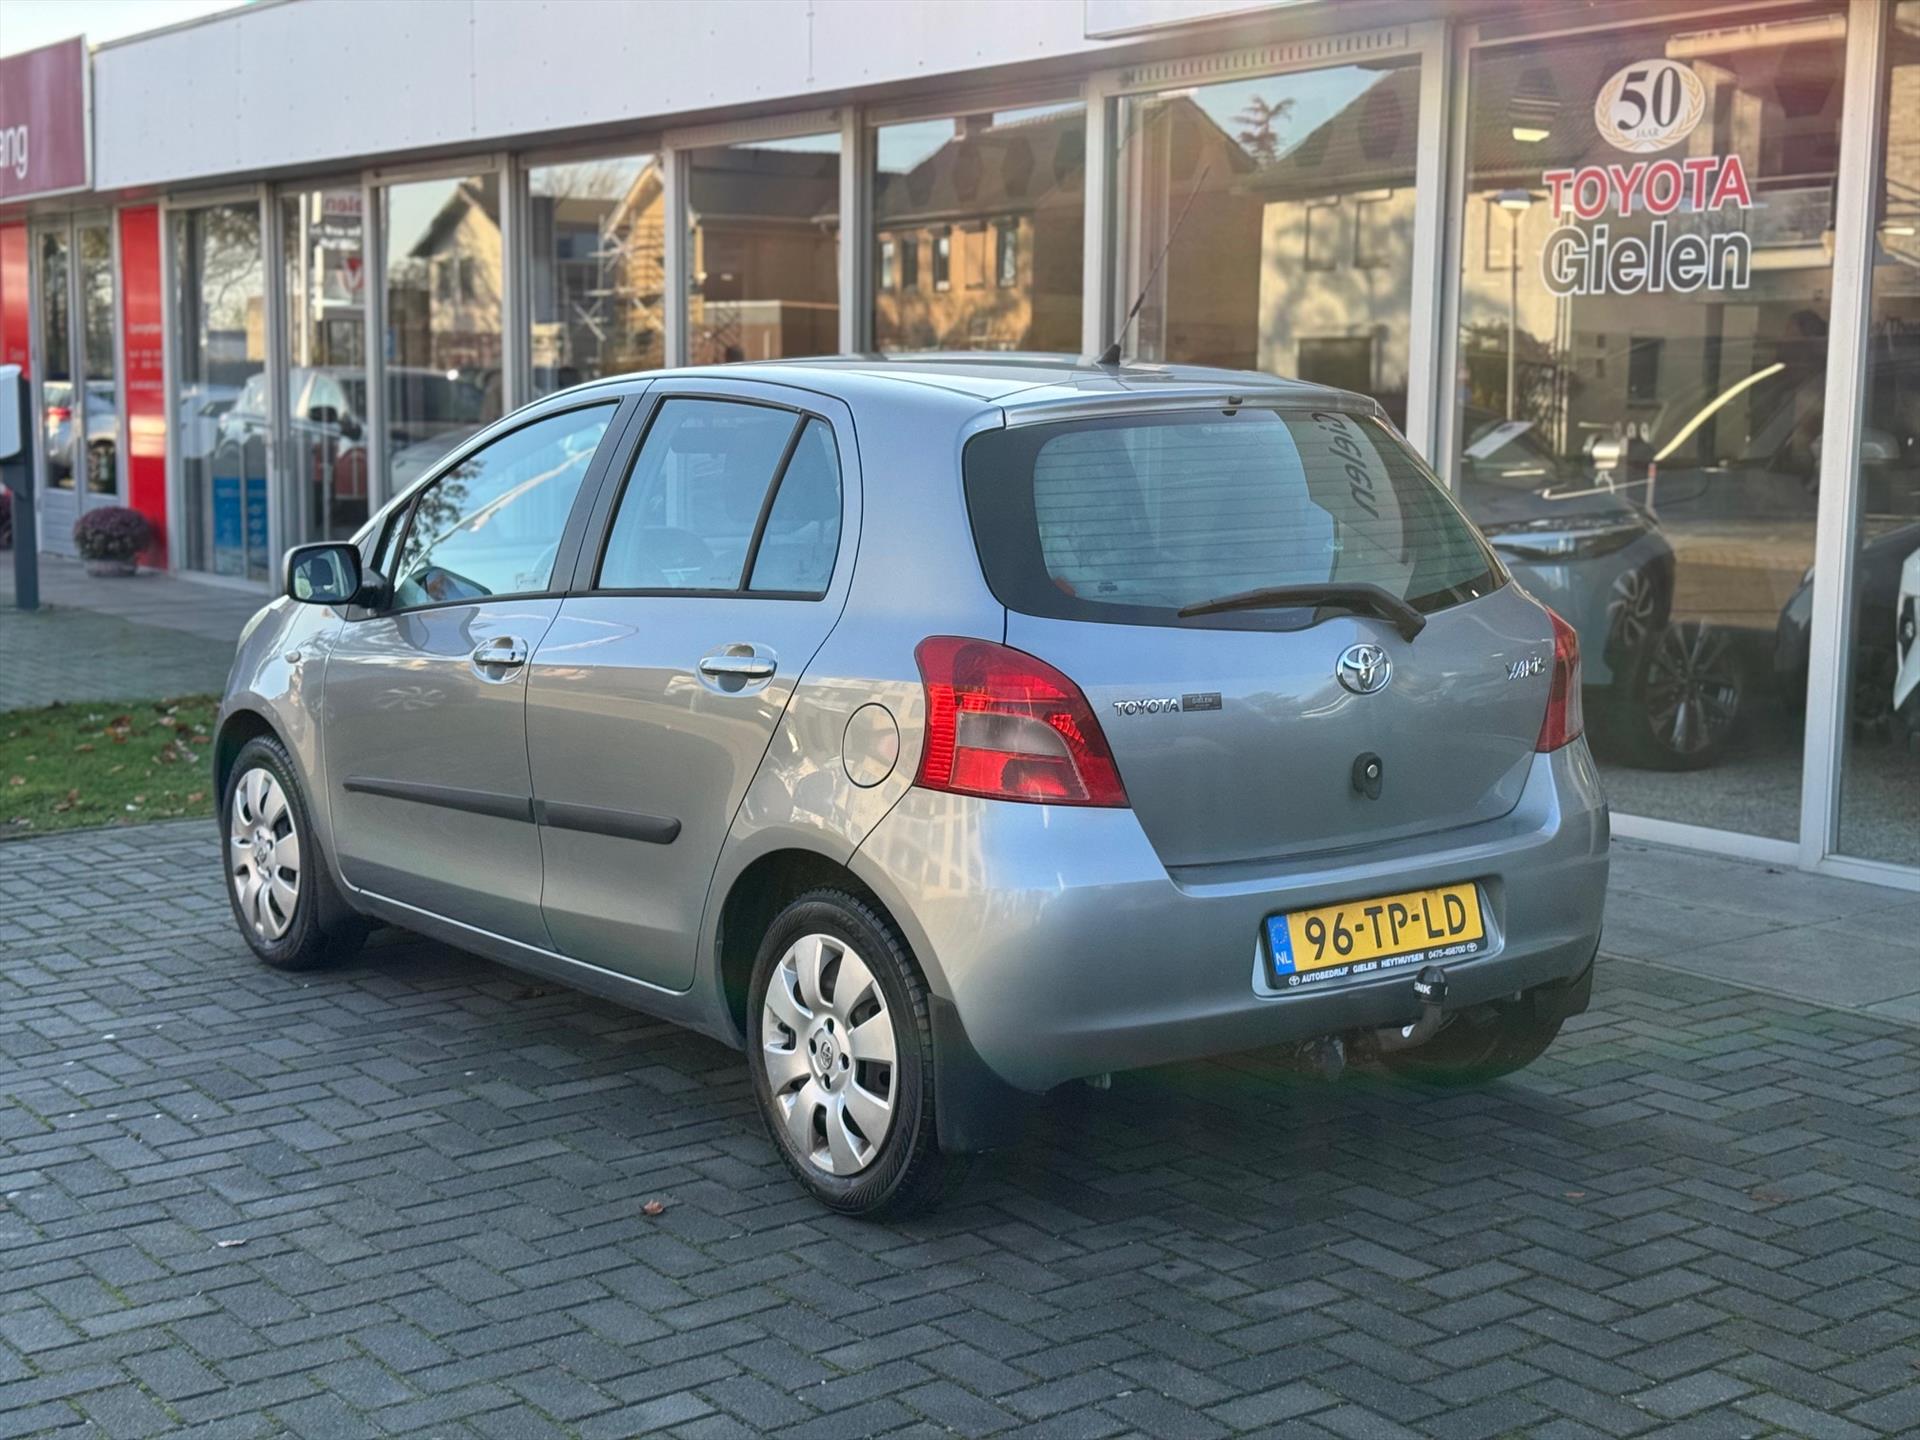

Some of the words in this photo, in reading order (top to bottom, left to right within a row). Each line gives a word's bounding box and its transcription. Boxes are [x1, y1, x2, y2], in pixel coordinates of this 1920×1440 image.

[1617, 66, 1682, 131] 50
[1543, 154, 1752, 219] TOYOTA
[1541, 220, 1752, 297] Gielen
[1113, 698, 1180, 717] TOYOTA
[1275, 951, 1292, 965] NL
[1304, 893, 1467, 962] 96-TP-LD
[1301, 966, 1349, 984] AUTOBEDRIJF
[1353, 962, 1377, 974] GIELEN
[1381, 952, 1425, 968] HEYTHUYSEN
